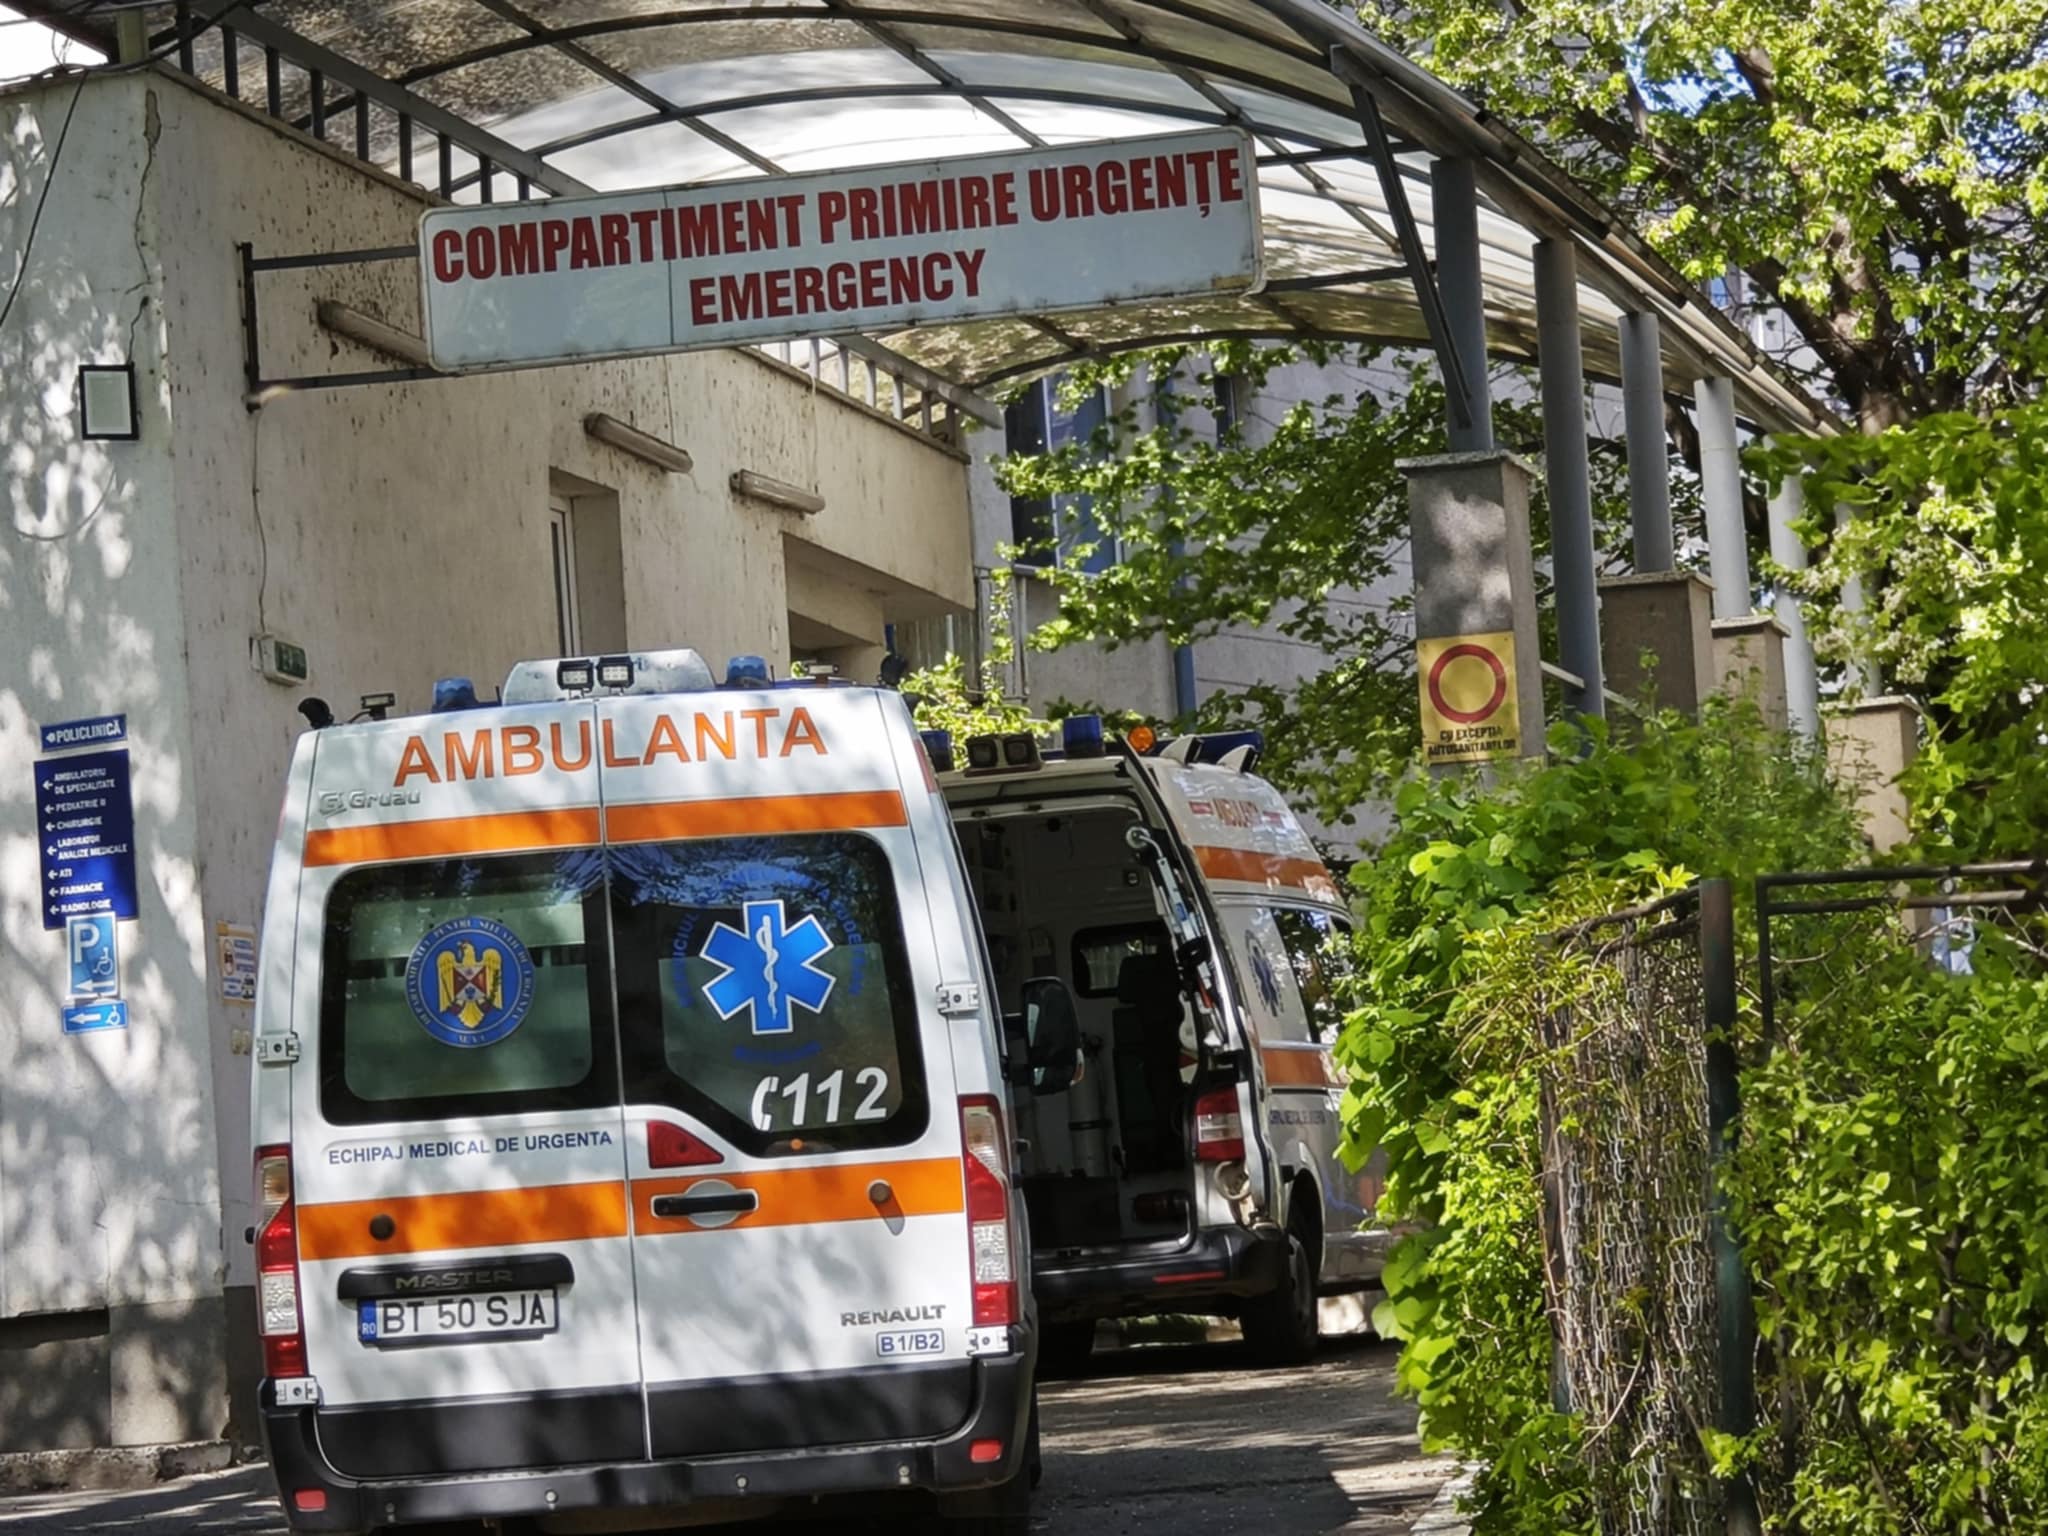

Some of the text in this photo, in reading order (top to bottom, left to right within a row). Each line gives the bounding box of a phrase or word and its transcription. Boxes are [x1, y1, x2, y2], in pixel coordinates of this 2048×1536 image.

[432, 193, 806, 284] COMPARTIMENT
[819, 171, 1019, 244] PRIMIRE
[690, 248, 986, 327] EMERGENCY
[393, 706, 829, 788] AMBULANTA
[349, 789, 421, 809] Gruau
[74, 922, 100, 964] P
[782, 1066, 888, 1126] 112
[329, 1131, 612, 1165] ECHIPAJ MEDICAL DE URGENTA
[395, 1269, 513, 1290] MASTER
[361, 1322, 377, 1336] RO
[383, 1292, 547, 1334] BT 50 SJA
[840, 1304, 946, 1327] RENAULT
